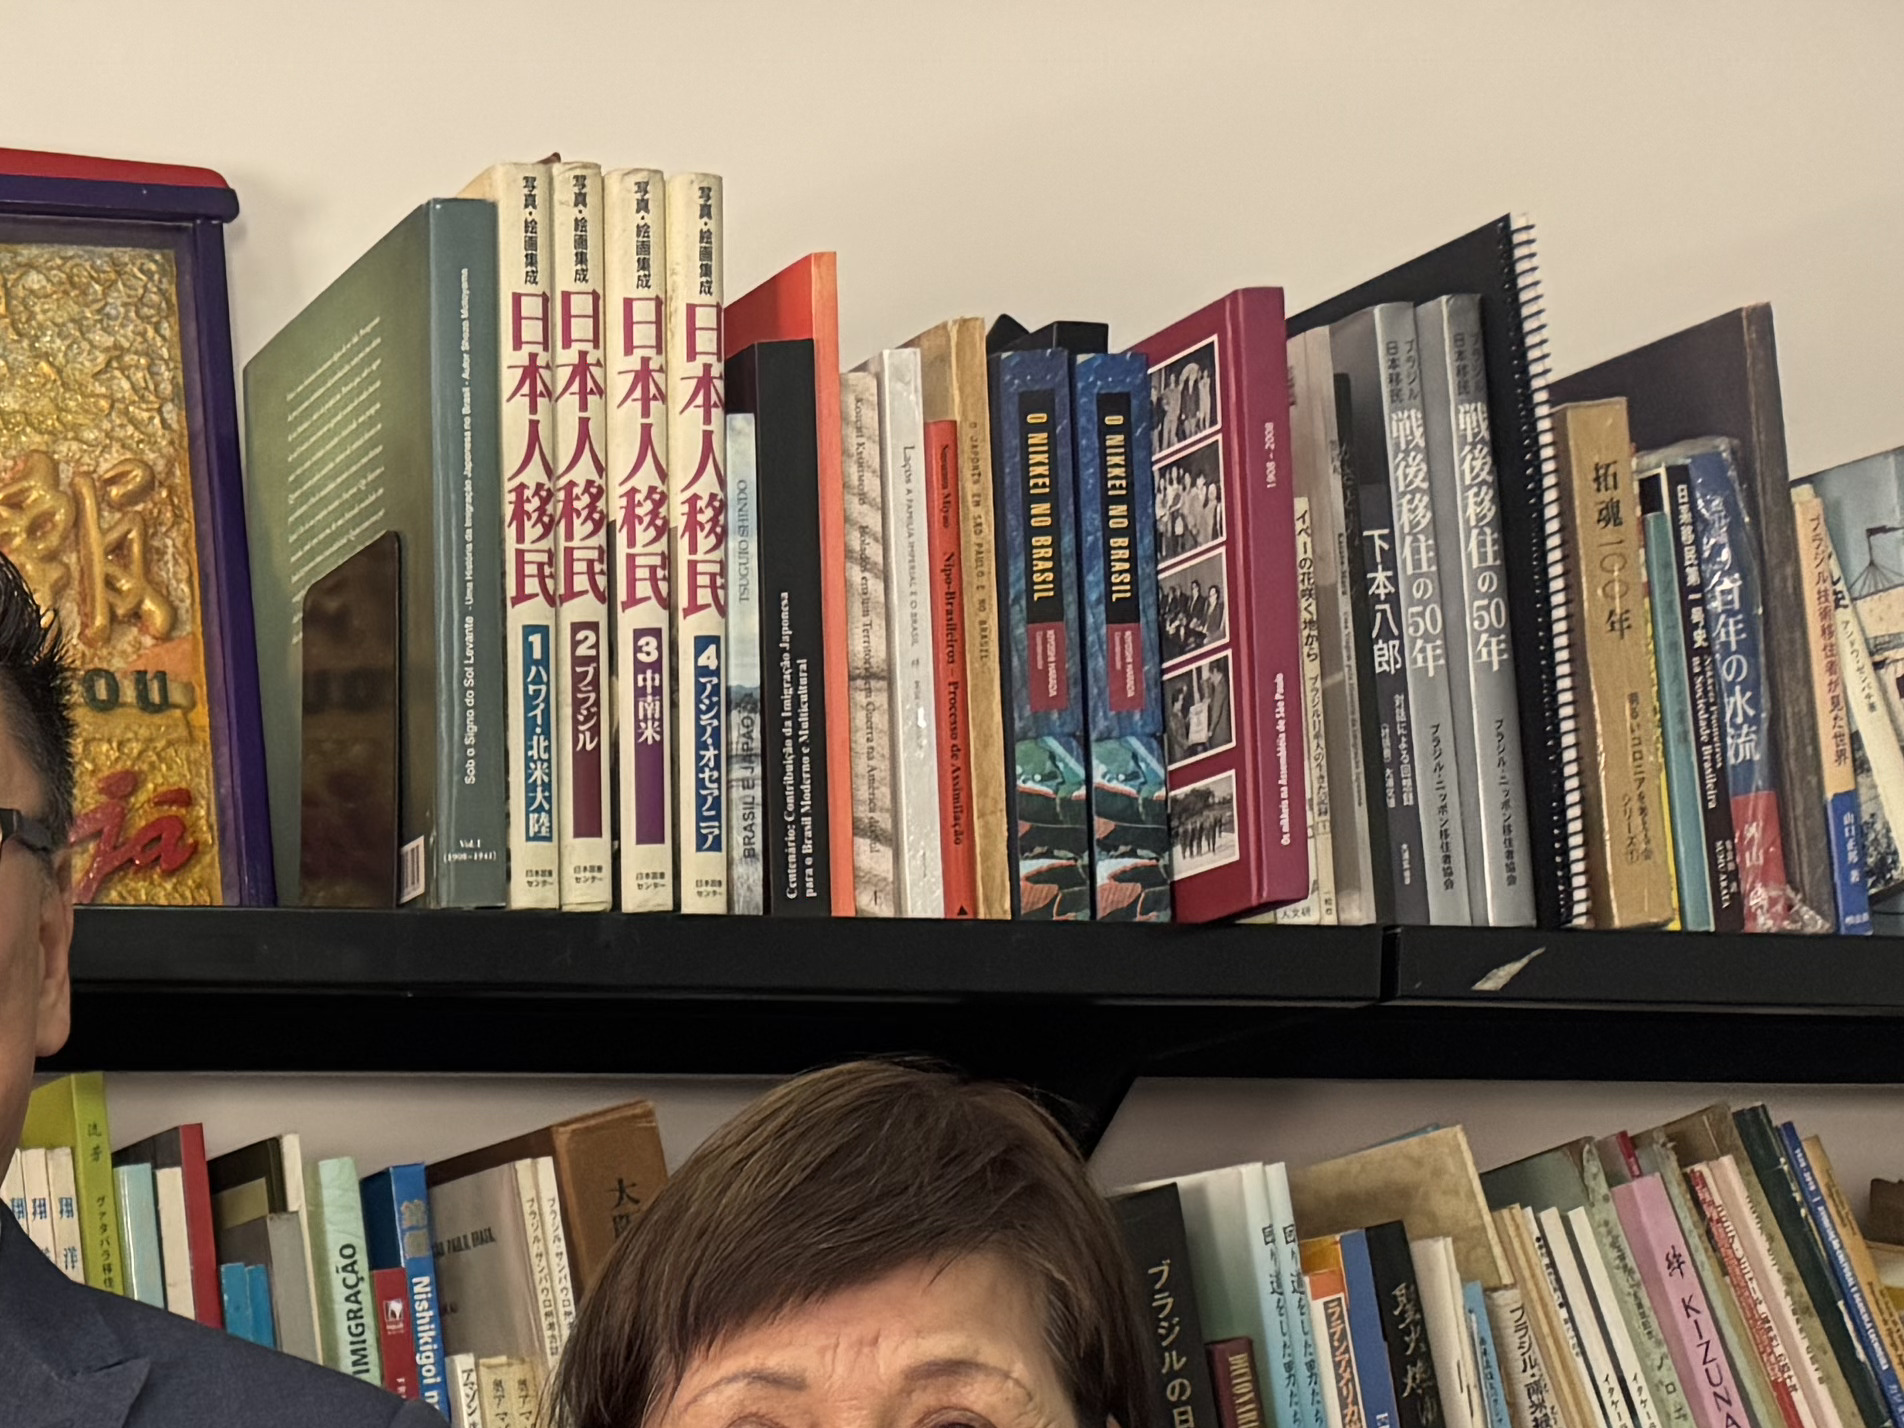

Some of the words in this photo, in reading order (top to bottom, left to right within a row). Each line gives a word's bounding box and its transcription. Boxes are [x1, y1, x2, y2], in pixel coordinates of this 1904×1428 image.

[506, 291, 556, 609] 日本人移民
[555, 289, 607, 607] 日本人移民
[1026, 413, 1048, 424] O
[1104, 415, 1124, 426] O
[617, 297, 669, 613] 日本人移民
[679, 302, 726, 620] 日本人移民
[1027, 432, 1050, 494] NIKKEI
[1105, 434, 1128, 496] NIKKEI
[1030, 503, 1052, 527] NO
[1108, 504, 1129, 529] NO
[1391, 409, 1445, 678] 戦後移住の50年
[1458, 402, 1510, 673] 戦後移住の50年
[1032, 536, 1055, 602] BRASIL
[1110, 537, 1132, 602] BRASIL
[1363, 529, 1401, 676] 下本八郎
[527, 633, 542, 660] 1
[575, 630, 597, 656] 2
[637, 636, 658, 663] 3
[698, 644, 719, 670] 4
[575, 663, 599, 752] ブラジル
[637, 669, 661, 745] 中南米
[526, 665, 551, 838] ハワイ・北米大陸
[801, 814, 813, 854] Brasil
